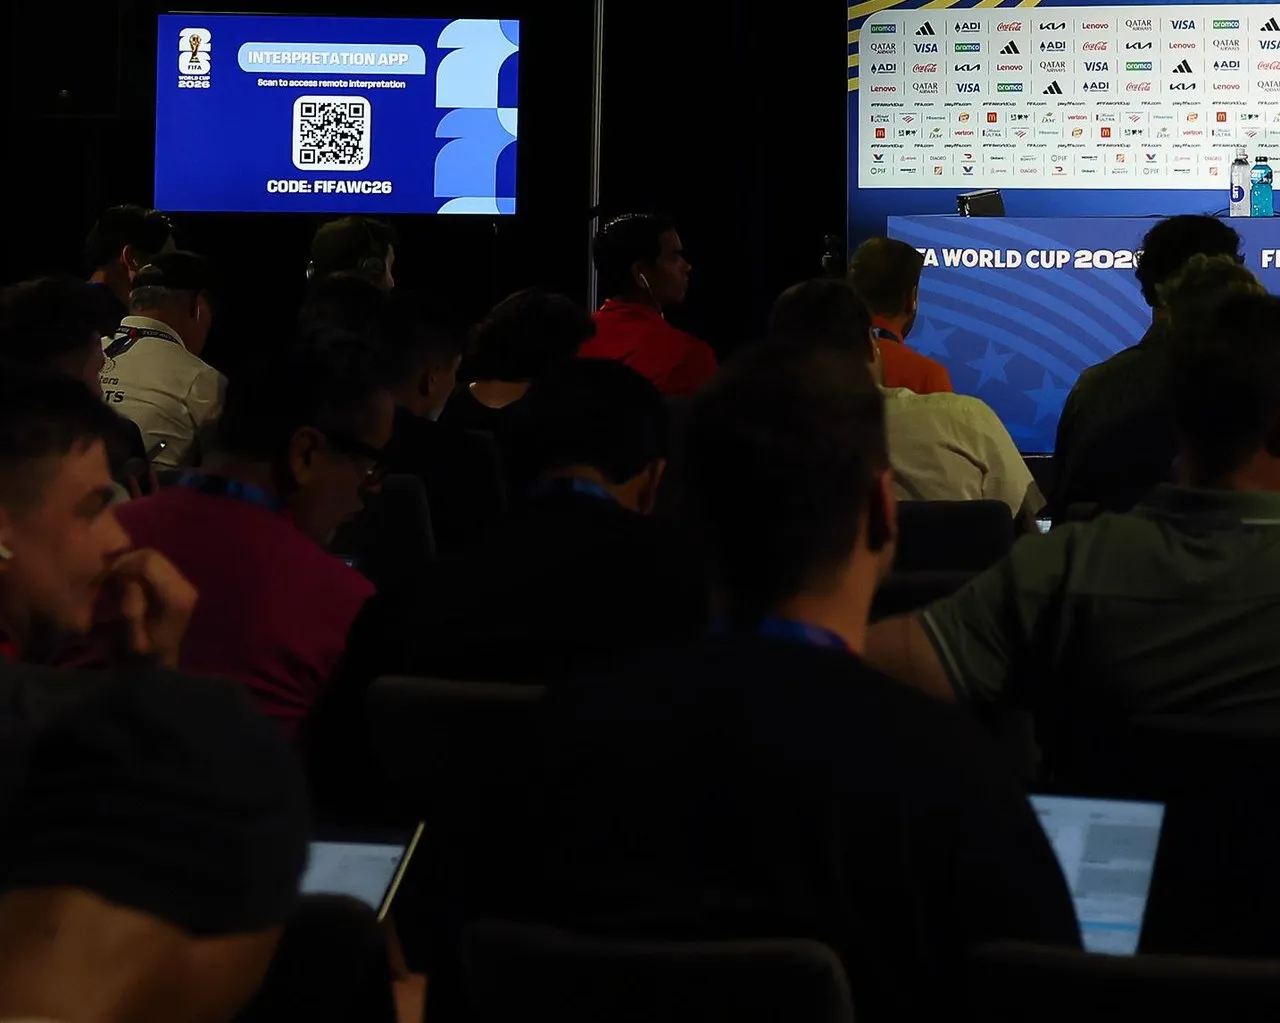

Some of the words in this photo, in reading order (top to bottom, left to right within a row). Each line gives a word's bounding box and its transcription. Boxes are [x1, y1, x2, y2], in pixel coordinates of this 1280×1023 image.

[1039, 22, 1066, 30] KIA
[1125, 19, 1152, 27] QATAR
[1170, 20, 1195, 30] VISA
[1212, 39, 1239, 47] QATAR
[913, 43, 938, 53] VISA
[248, 51, 375, 65] INTERPRETATION
[377, 53, 409, 66] APP
[878, 63, 896, 71] ADI
[258, 79, 278, 87] Scan
[279, 79, 287, 87] to
[319, 80, 348, 88] remote
[912, 82, 938, 90] QATAR
[956, 83, 980, 93] VISA
[267, 179, 312, 193] CODE:
[313, 180, 392, 194] FIFAWC26
[942, 248, 1022, 268] WORLD
[1026, 250, 1071, 269] CUP
